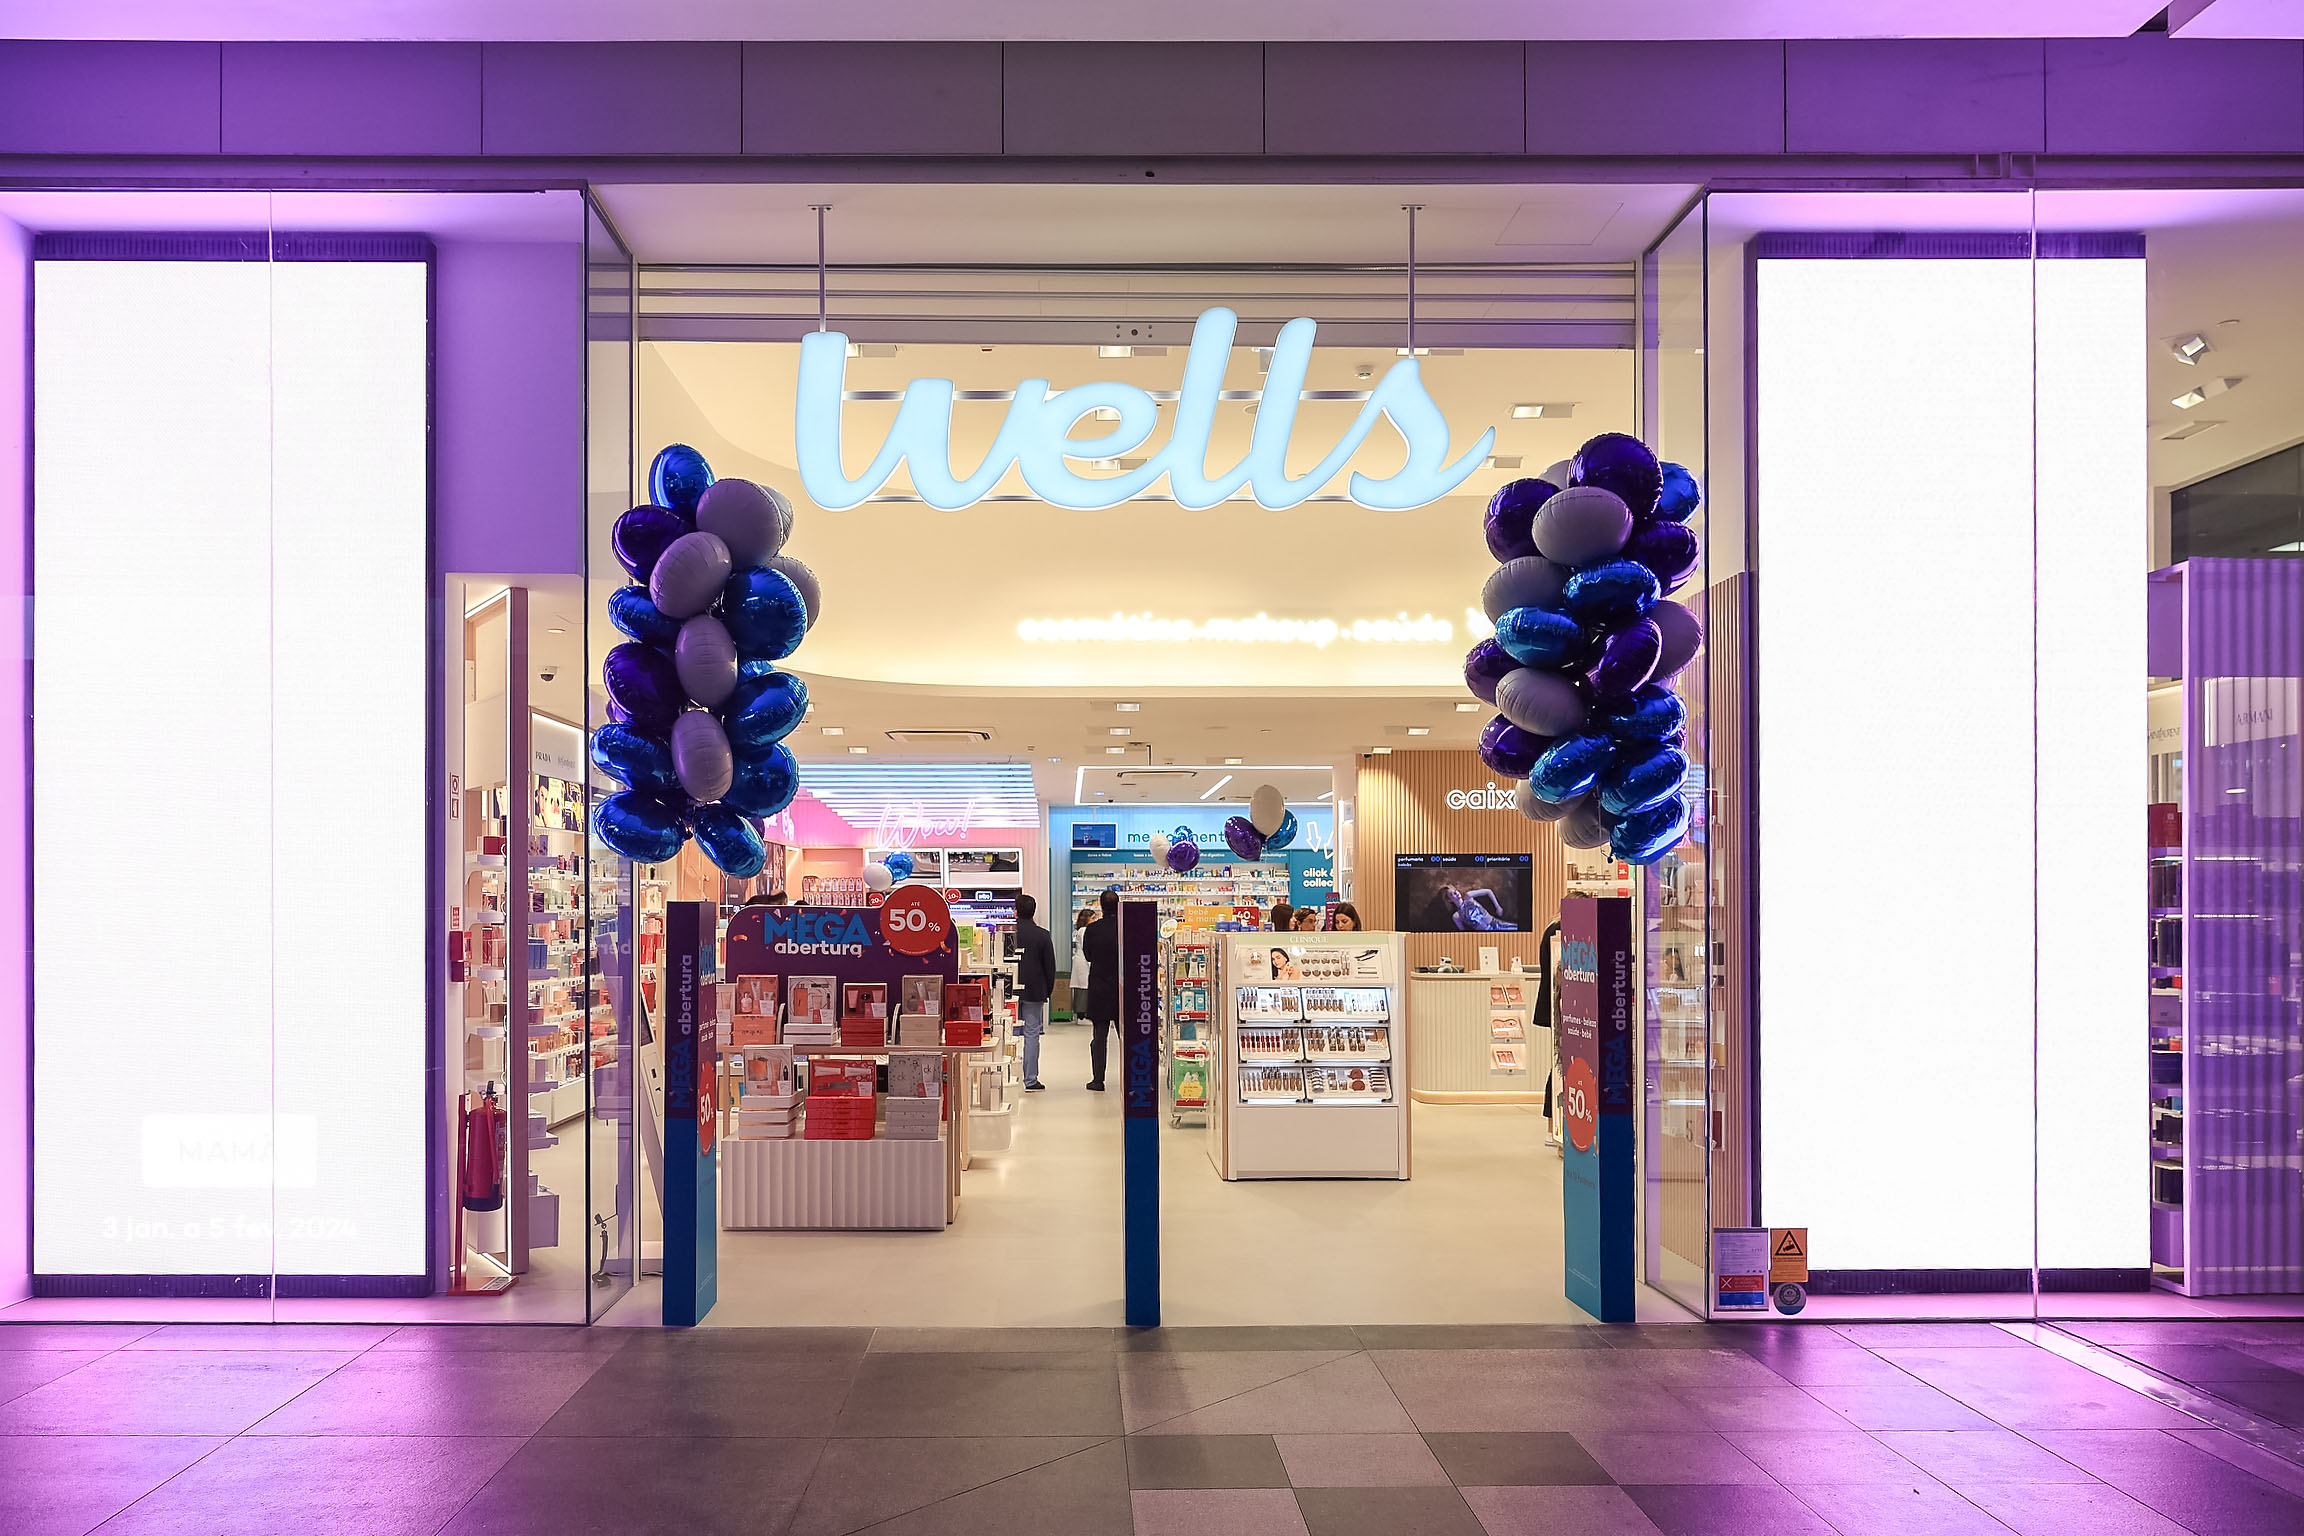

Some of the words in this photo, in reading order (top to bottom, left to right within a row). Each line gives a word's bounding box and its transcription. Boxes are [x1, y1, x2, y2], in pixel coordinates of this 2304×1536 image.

[795, 306, 1496, 511] wells
[1446, 781, 1517, 810] caix
[877, 801, 976, 848] Wow!
[1303, 867, 1328, 878] click
[1303, 878, 1334, 888] collec
[764, 912, 873, 946] MEGA
[888, 908, 941, 933] 50%
[774, 938, 863, 956] abertura
[1289, 935, 1329, 944] CLINIQUE
[1561, 940, 1598, 974] MEGA
[1563, 964, 1595, 984] abertura
[678, 954, 692, 1036] abertura
[1136, 954, 1151, 1035] abertura
[1611, 950, 1627, 1032] abertura
[671, 1038, 692, 1109] MEGA
[1130, 1038, 1152, 1108] MEGA
[1604, 1033, 1627, 1105] MEGA
[102, 1217, 118, 1239] 3
[126, 1216, 175, 1243] jan.
[183, 1221, 200, 1239] a
[209, 1217, 225, 1239] 5
[290, 1217, 358, 1239] 2024
